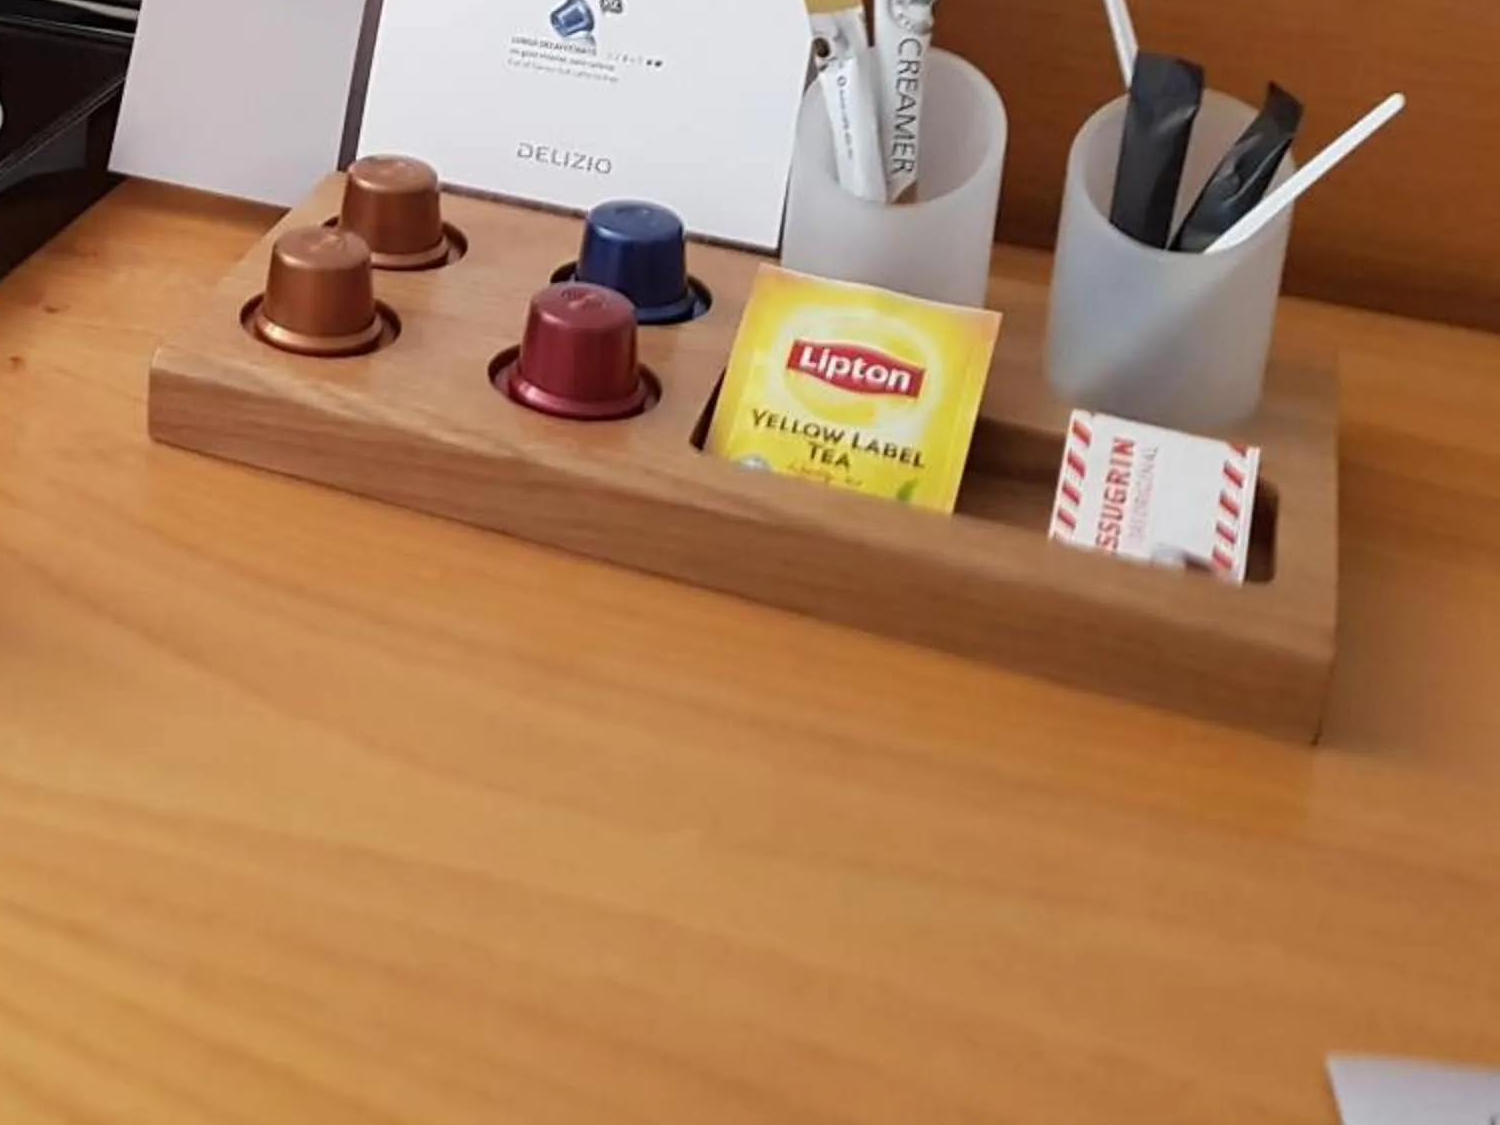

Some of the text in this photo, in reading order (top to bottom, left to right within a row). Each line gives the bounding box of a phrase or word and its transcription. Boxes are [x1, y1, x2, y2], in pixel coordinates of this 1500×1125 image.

[890, 37, 922, 175] CREAMER
[516, 142, 613, 175] DELIZIO
[800, 345, 911, 392] Lipton
[751, 408, 926, 469] YELLOW LABEL
[807, 443, 851, 470] TEA
